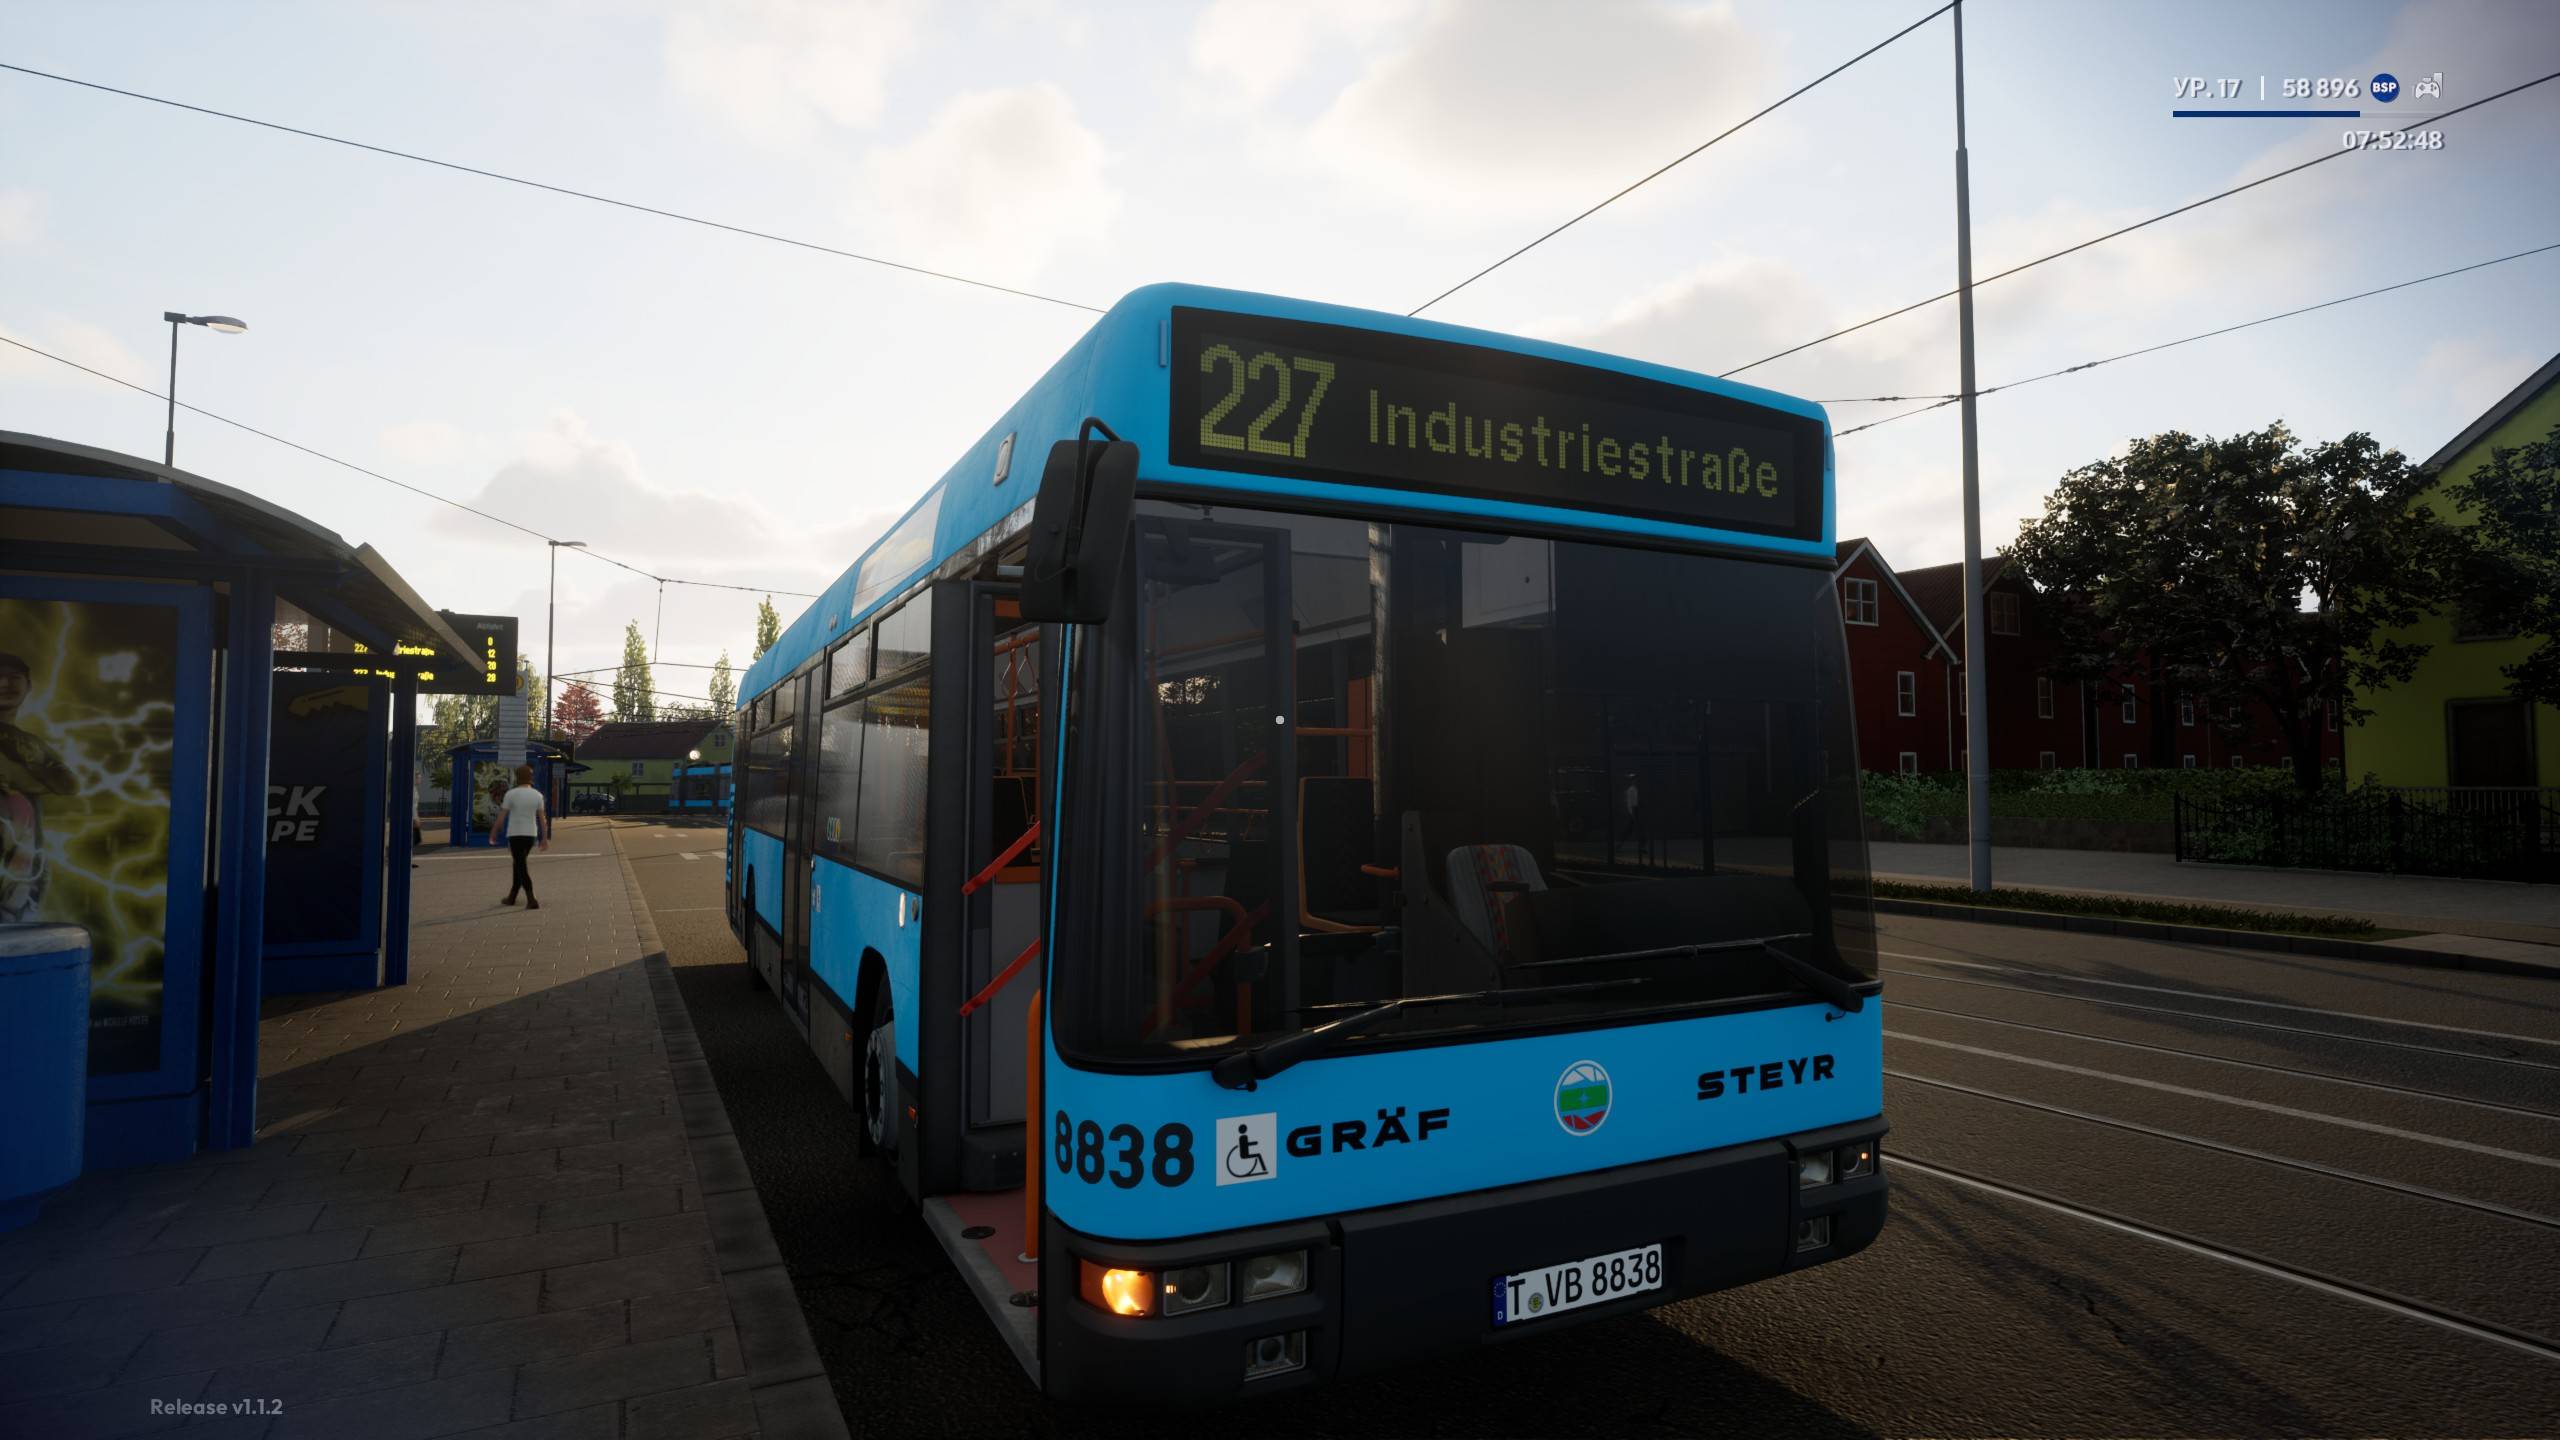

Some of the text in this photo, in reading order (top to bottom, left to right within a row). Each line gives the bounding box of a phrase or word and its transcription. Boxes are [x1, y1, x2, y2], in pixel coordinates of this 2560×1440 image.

[1200, 344, 1778, 497] 227 Industriestraße
[1697, 1054, 1835, 1100] STEYR
[1055, 1110, 1194, 1189] 8838
[1286, 1107, 1450, 1158] GRÄF
[1508, 1250, 1661, 1316] T VB 8838
[1497, 1311, 1503, 1321] D
